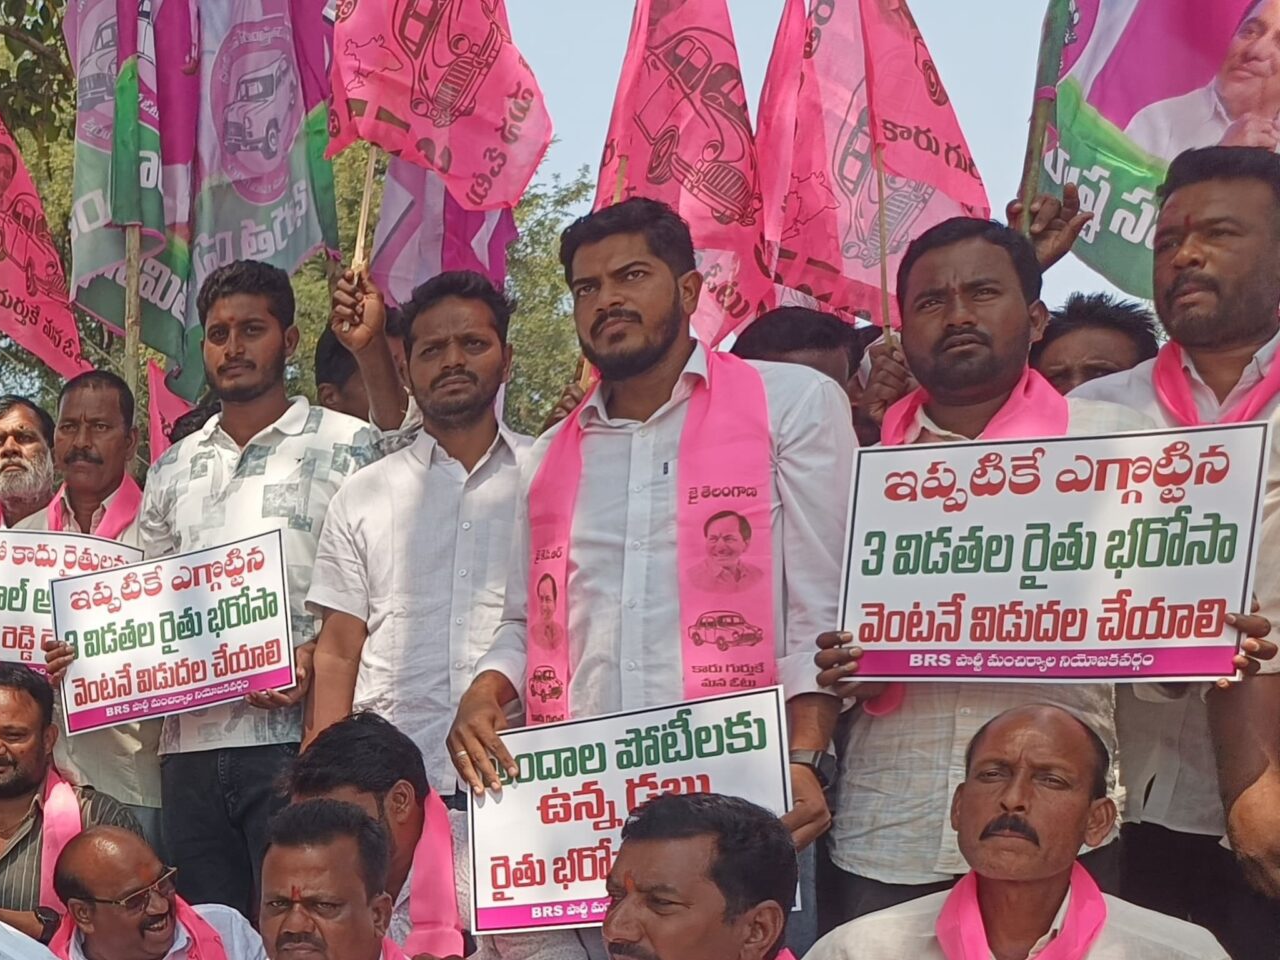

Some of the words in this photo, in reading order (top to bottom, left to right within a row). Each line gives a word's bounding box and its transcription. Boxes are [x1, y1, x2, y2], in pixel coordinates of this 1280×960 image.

[881, 119, 938, 156] కారు
[42, 318, 62, 348] మన
[688, 487, 698, 505] జై
[701, 485, 757, 498] తెలంగాణ
[883, 447, 1045, 513] ఇప్పటికే
[1055, 440, 1231, 504] ఎగ్గొట్టిన
[12, 544, 57, 567] కాదు
[861, 530, 886, 576] 3
[893, 525, 1015, 575] విడతల
[1020, 521, 1096, 589] రైతు
[1104, 505, 1239, 579] భరోసా
[71, 565, 163, 613] ఇప్పటికే
[171, 546, 266, 593] ఎగ్గొట్టిన
[84, 619, 155, 658] విడతల
[160, 606, 202, 654] రైతు
[208, 586, 278, 638] భరోసా
[858, 593, 966, 643] వెంటనే
[969, 599, 1088, 642] విడుదల
[1097, 589, 1227, 642] చేయాలి
[2, 626, 35, 661] రెడ్డి
[909, 653, 951, 667] BRS
[956, 653, 984, 671] పార్టీ
[986, 652, 1057, 672] మంచిర్యాల
[1059, 651, 1154, 672] నియోజకవర్గం
[72, 662, 132, 707] వెంటనే
[137, 658, 206, 693] విడుదల
[211, 638, 282, 678] చేయాలి
[691, 664, 722, 673] కారు
[726, 662, 764, 676] గుర్తుకే
[701, 678, 726, 687] మన
[729, 678, 756, 687] ఓటు
[106, 703, 130, 717] BRS
[132, 702, 149, 713] పార్టీ
[151, 692, 193, 708] మంచిర్యాల
[194, 679, 249, 702] నియోజకవర్గం
[615, 708, 768, 770] పోటీలకు
[537, 780, 624, 831] ఉన్న
[491, 852, 545, 901] రైతు
[553, 839, 620, 891] భరో
[531, 906, 563, 919] BRS
[567, 904, 588, 920] పార్టీ
